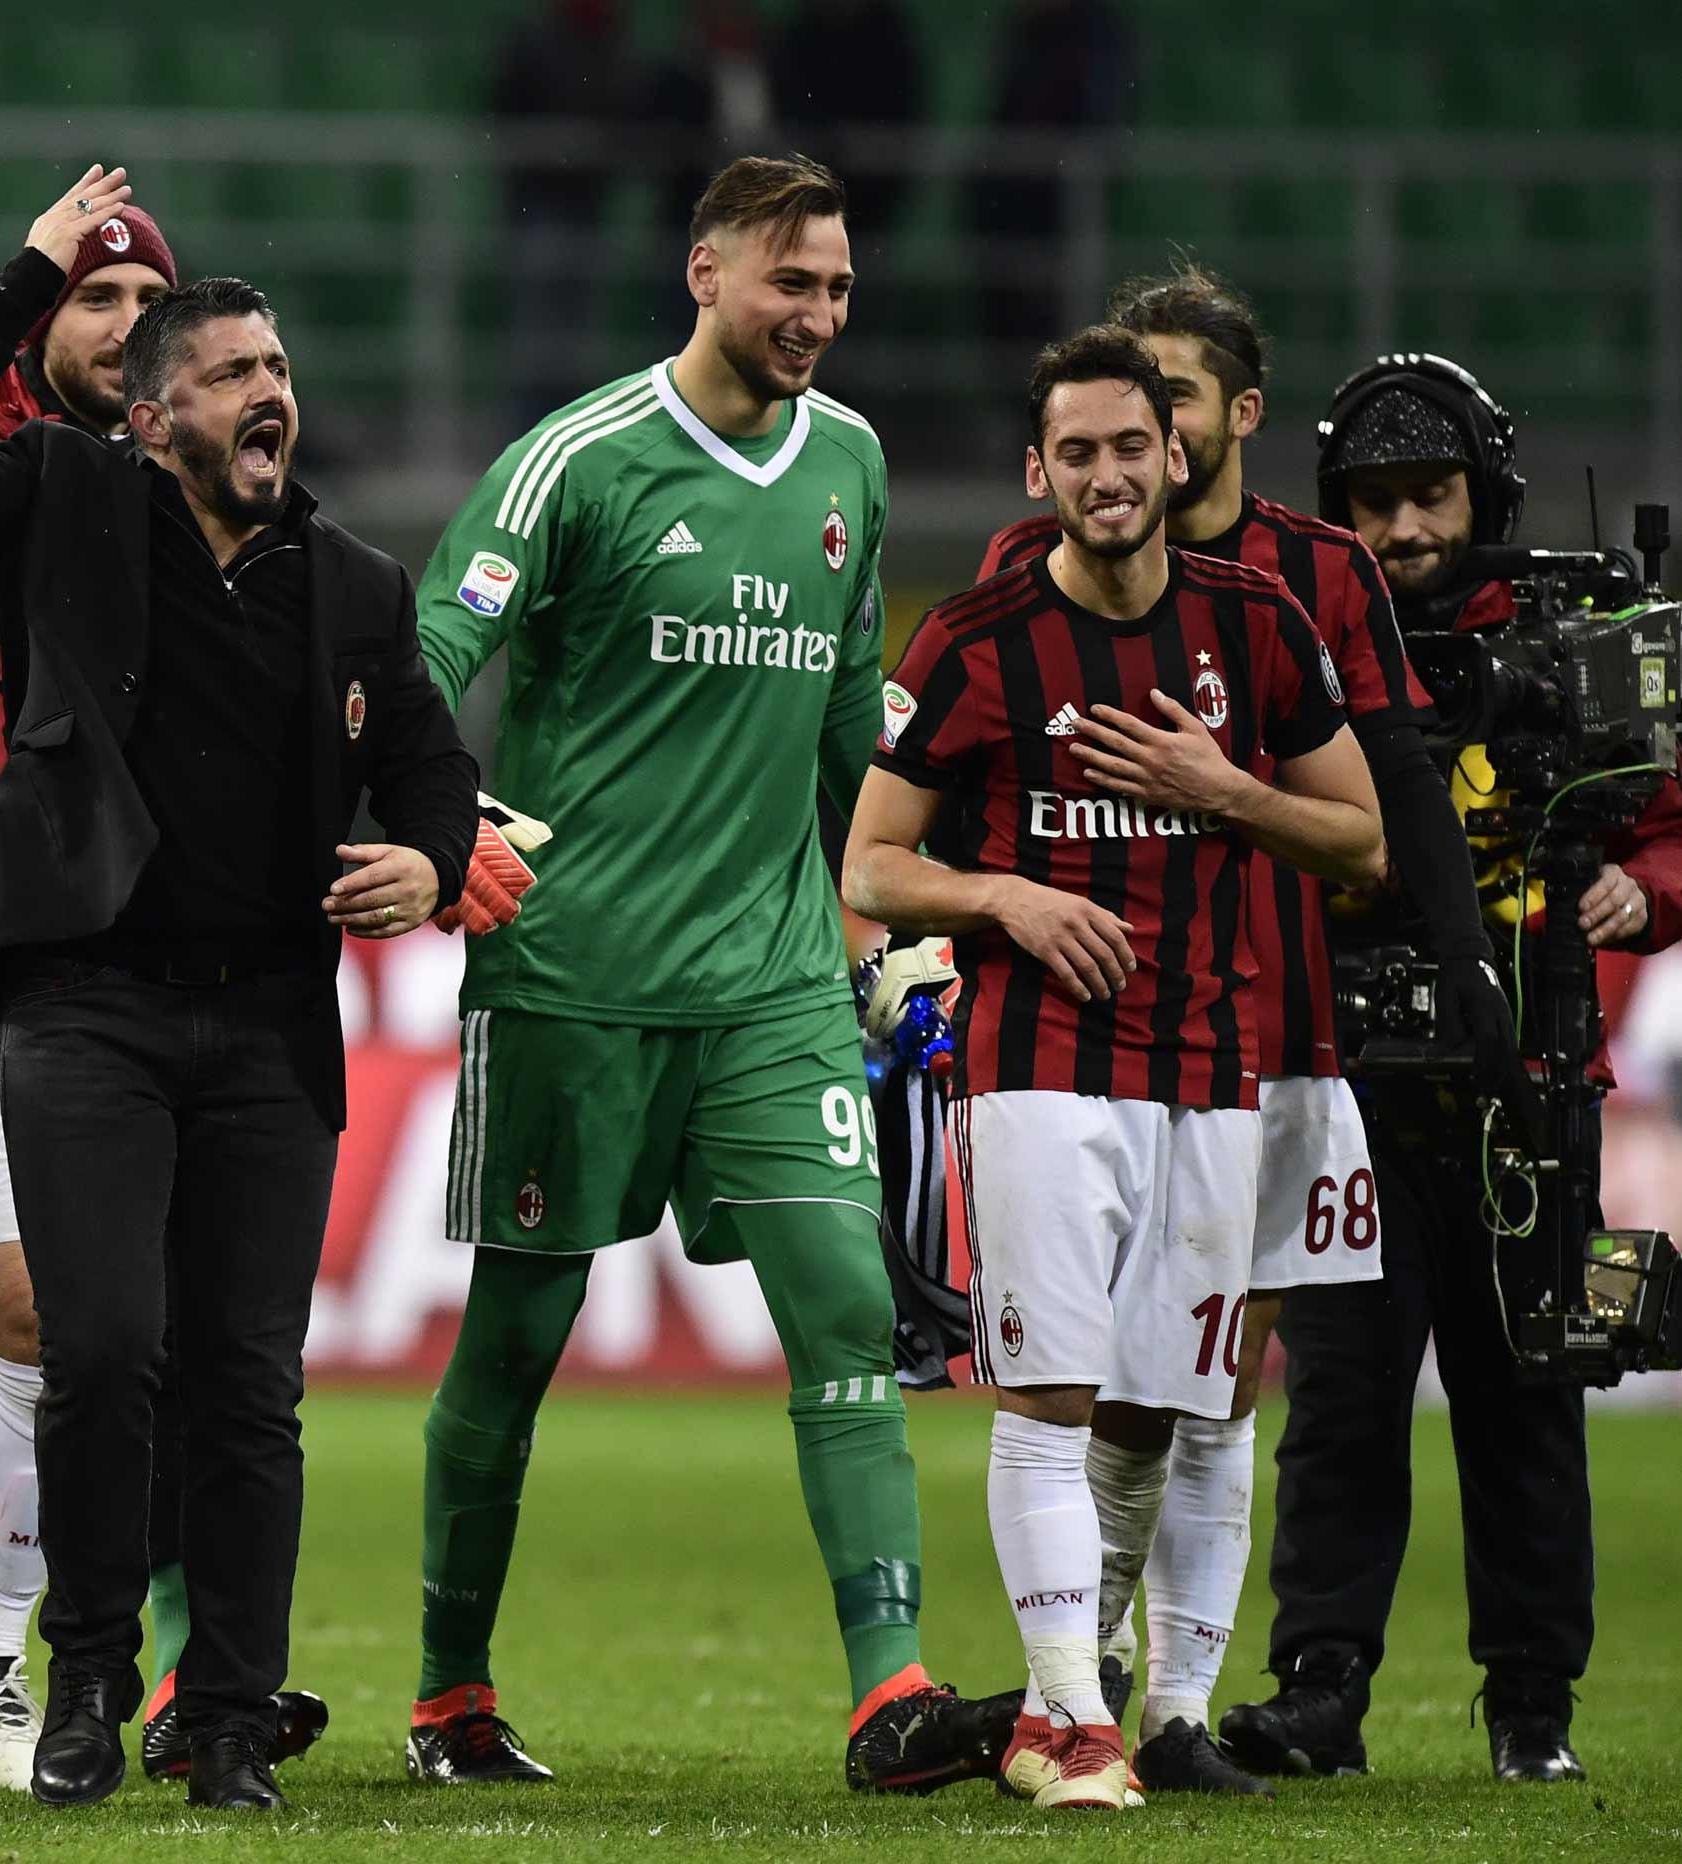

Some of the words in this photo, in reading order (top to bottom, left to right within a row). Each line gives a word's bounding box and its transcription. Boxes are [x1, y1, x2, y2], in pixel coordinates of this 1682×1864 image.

[657, 541, 703, 554] adidas
[476, 595, 496, 612] TIM
[732, 573, 789, 618] Fly
[650, 612, 838, 673] Emirates
[1045, 723, 1076, 736] adid
[1028, 790, 1223, 840] Emira
[821, 1086, 879, 1178] 99
[1304, 1168, 1378, 1255] 68
[1191, 1293, 1246, 1378] 10
[1016, 1593, 1084, 1611] MILAN
